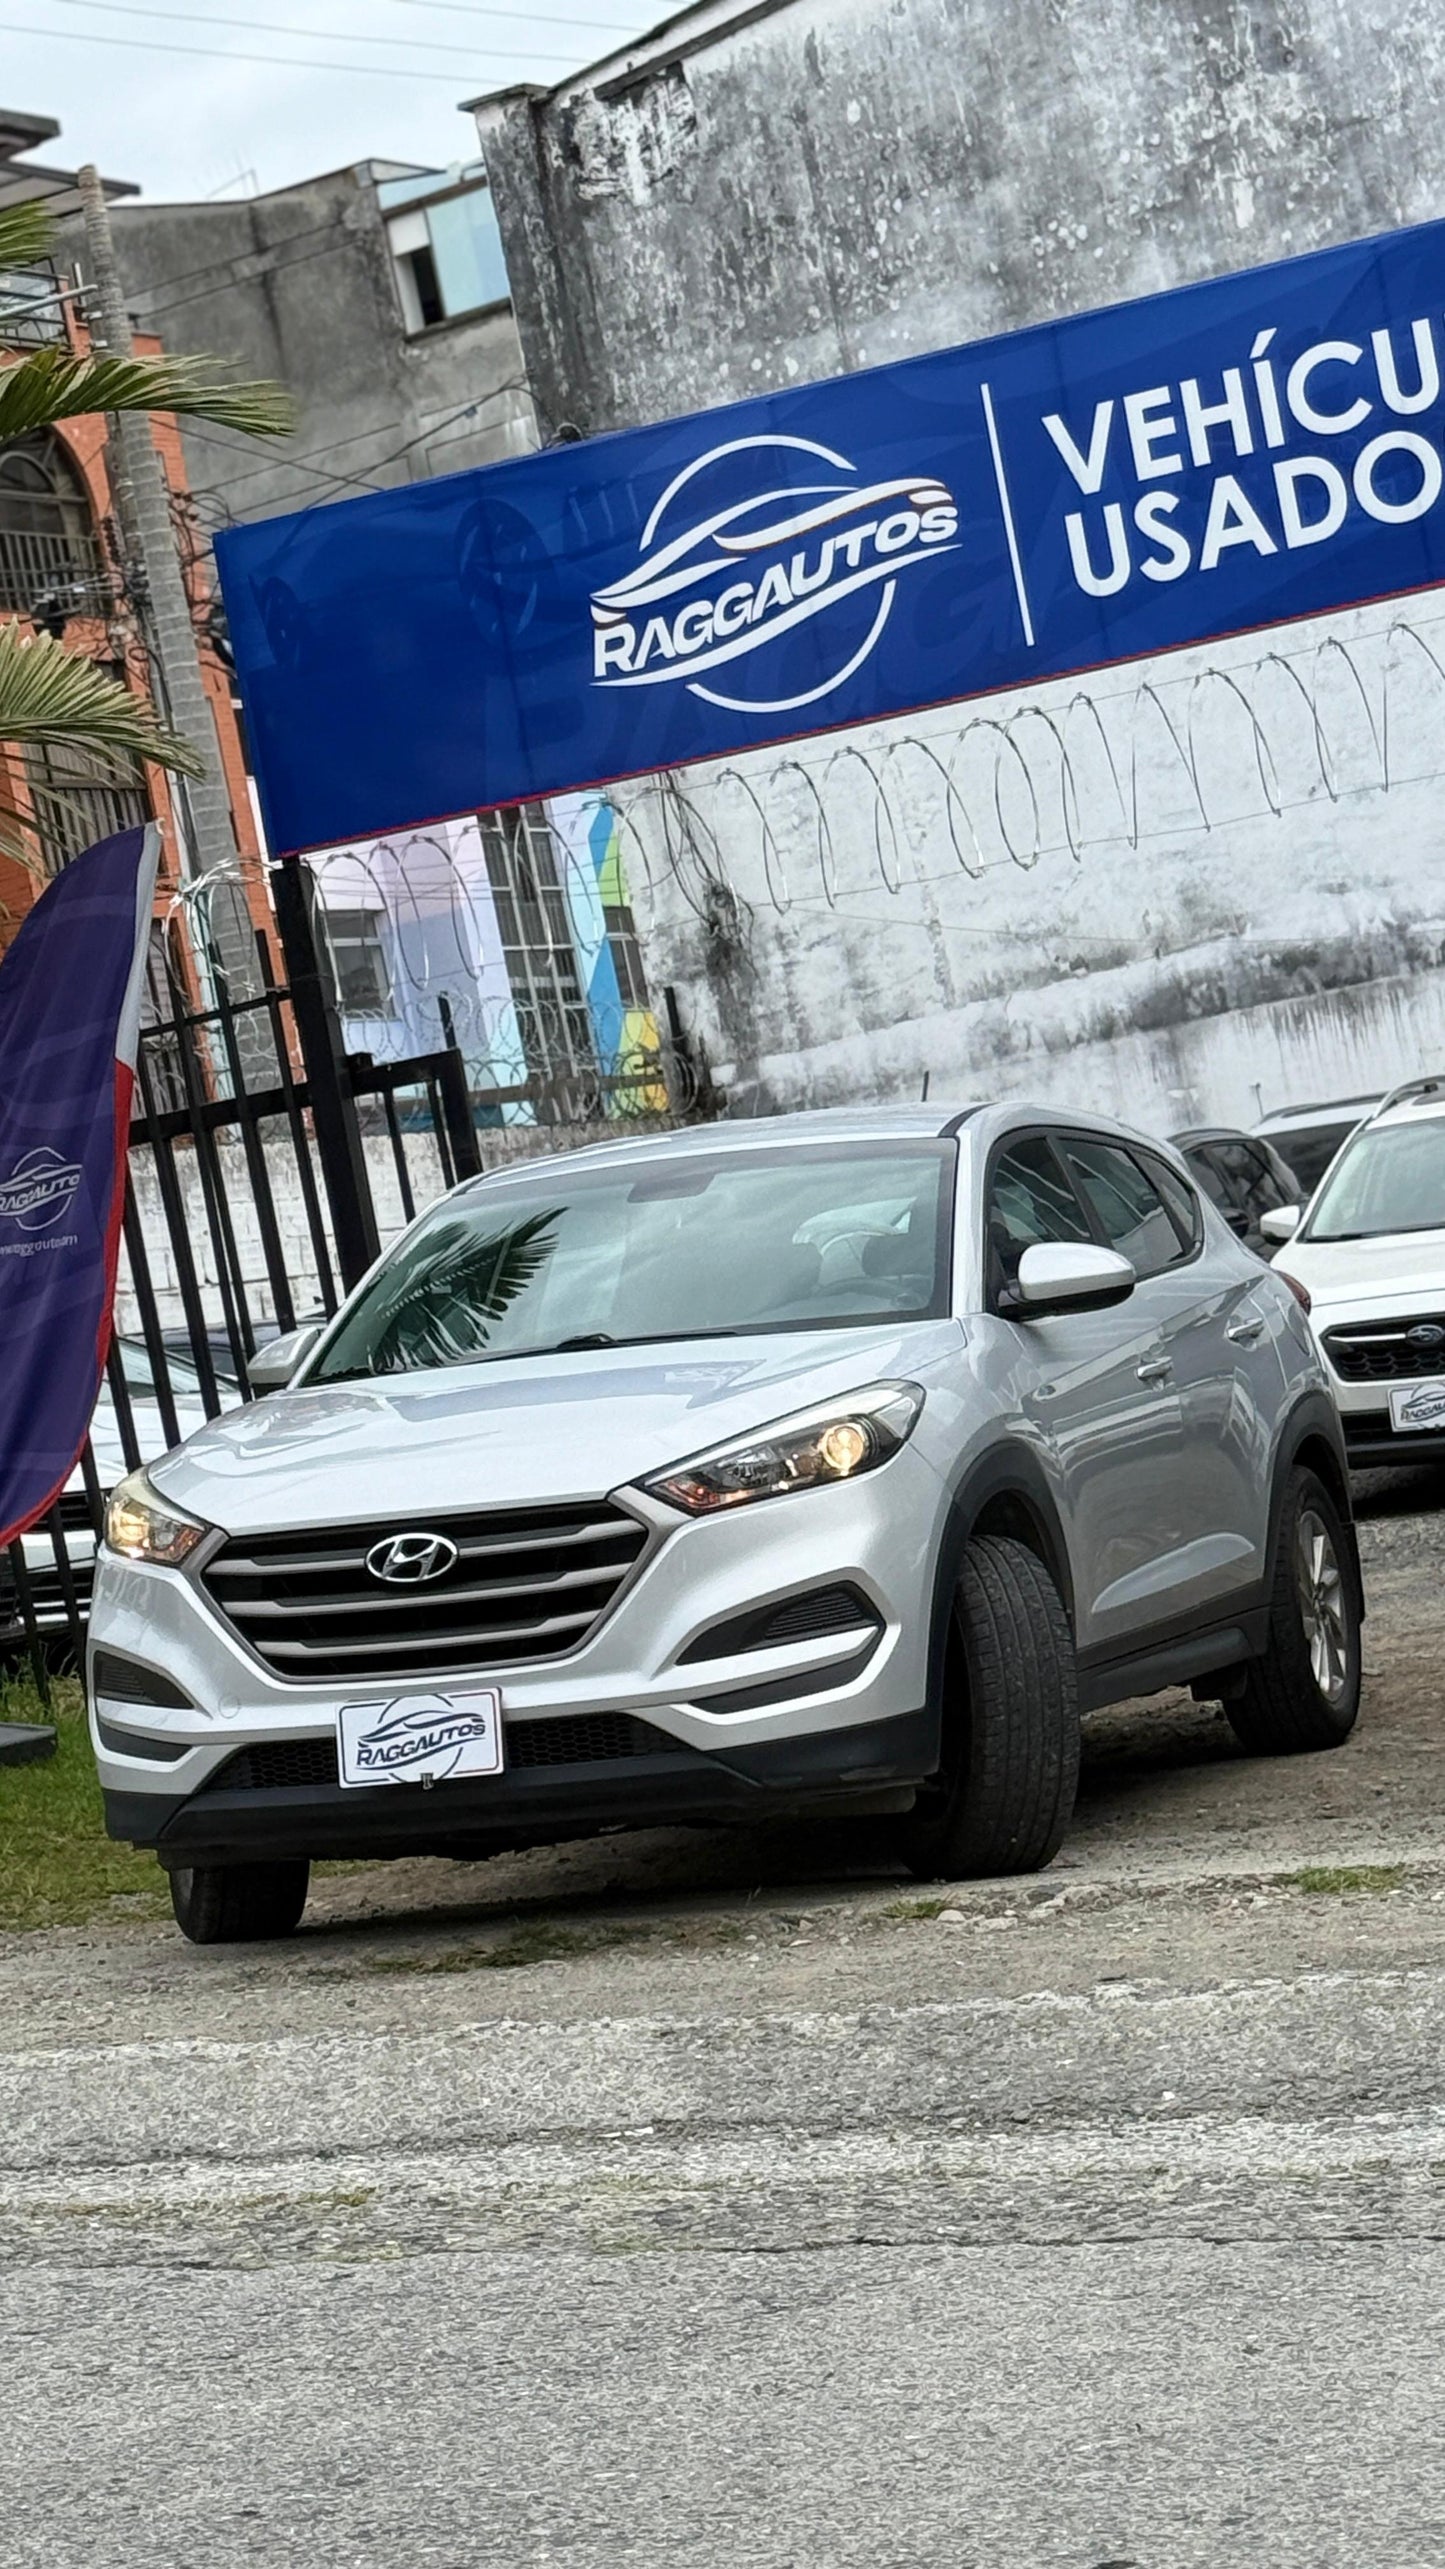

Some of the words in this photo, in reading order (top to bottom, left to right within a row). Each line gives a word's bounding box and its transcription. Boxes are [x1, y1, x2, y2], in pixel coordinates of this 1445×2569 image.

[1041, 328, 1440, 495] VEHÍCU
[594, 505, 958, 677] RAGGAUTOS
[1064, 430, 1443, 597] USADO
[357, 1724, 486, 1765] RAGGAUTOS
